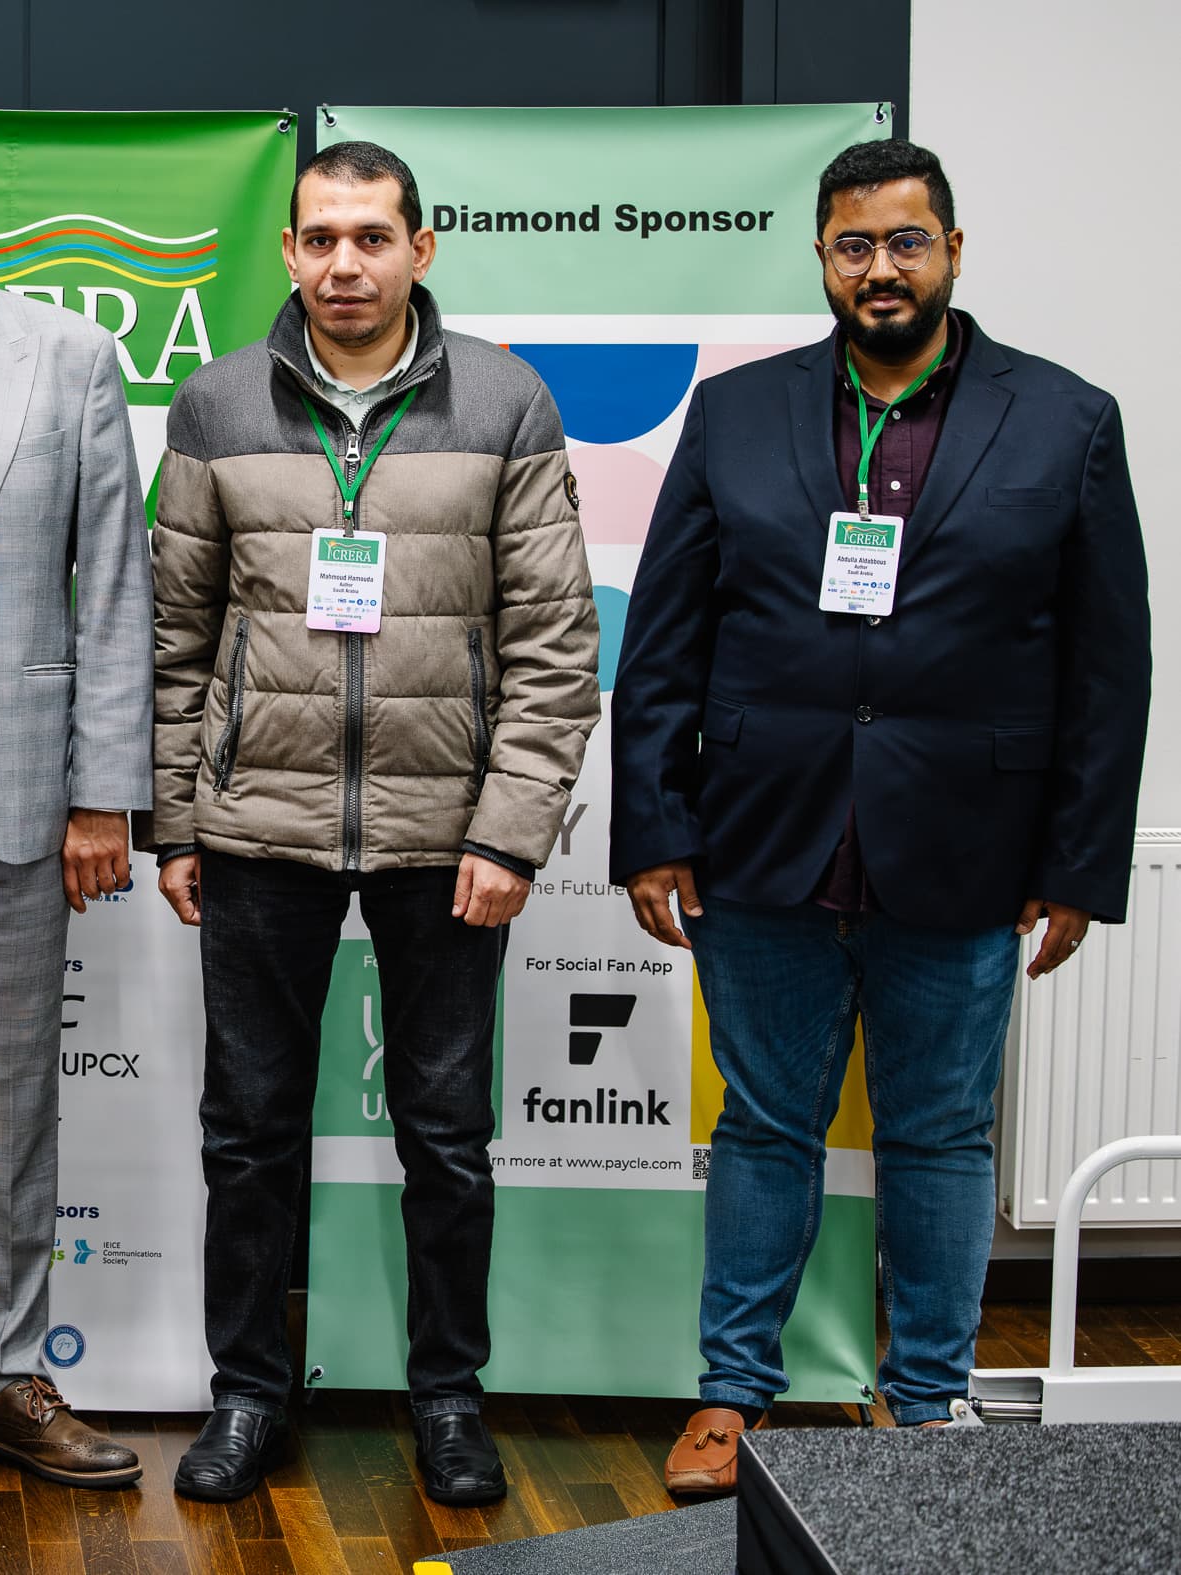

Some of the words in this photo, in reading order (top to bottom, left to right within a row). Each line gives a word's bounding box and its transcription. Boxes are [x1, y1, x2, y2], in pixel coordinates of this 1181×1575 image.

[433, 205, 600, 233] Diamond
[615, 204, 774, 239] Sponsor
[562, 879, 626, 896] Future
[526, 957, 551, 971] For
[556, 957, 602, 972] Social
[607, 959, 636, 973] Fan
[640, 960, 673, 976] App
[62, 1052, 140, 1079] UPCX
[522, 1086, 672, 1126] fanlink
[510, 1156, 546, 1167] more
[549, 1157, 563, 1168] at
[566, 1157, 682, 1171] www.paycle.com
[102, 1249, 163, 1258] Communications
[103, 1241, 121, 1249] IEICE
[102, 1257, 129, 1266] Society
